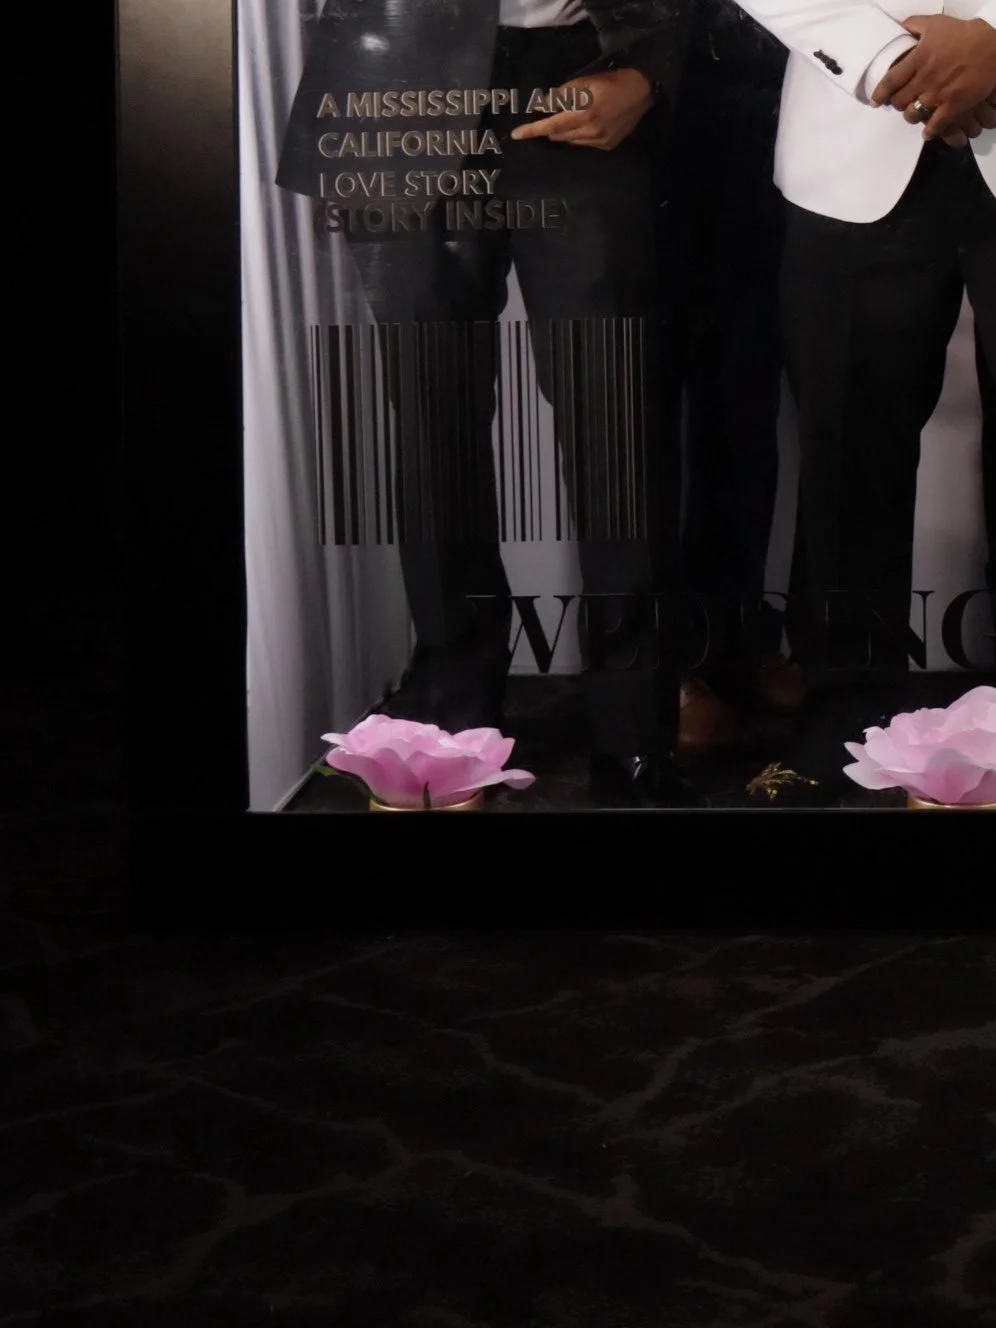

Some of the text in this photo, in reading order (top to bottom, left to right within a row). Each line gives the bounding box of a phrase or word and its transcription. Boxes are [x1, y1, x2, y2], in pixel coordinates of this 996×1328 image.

[316, 87, 595, 118] A MISSISSIPPI AND
[317, 129, 502, 159] CALIFORNIA
[319, 169, 501, 198] LOVE STORY
